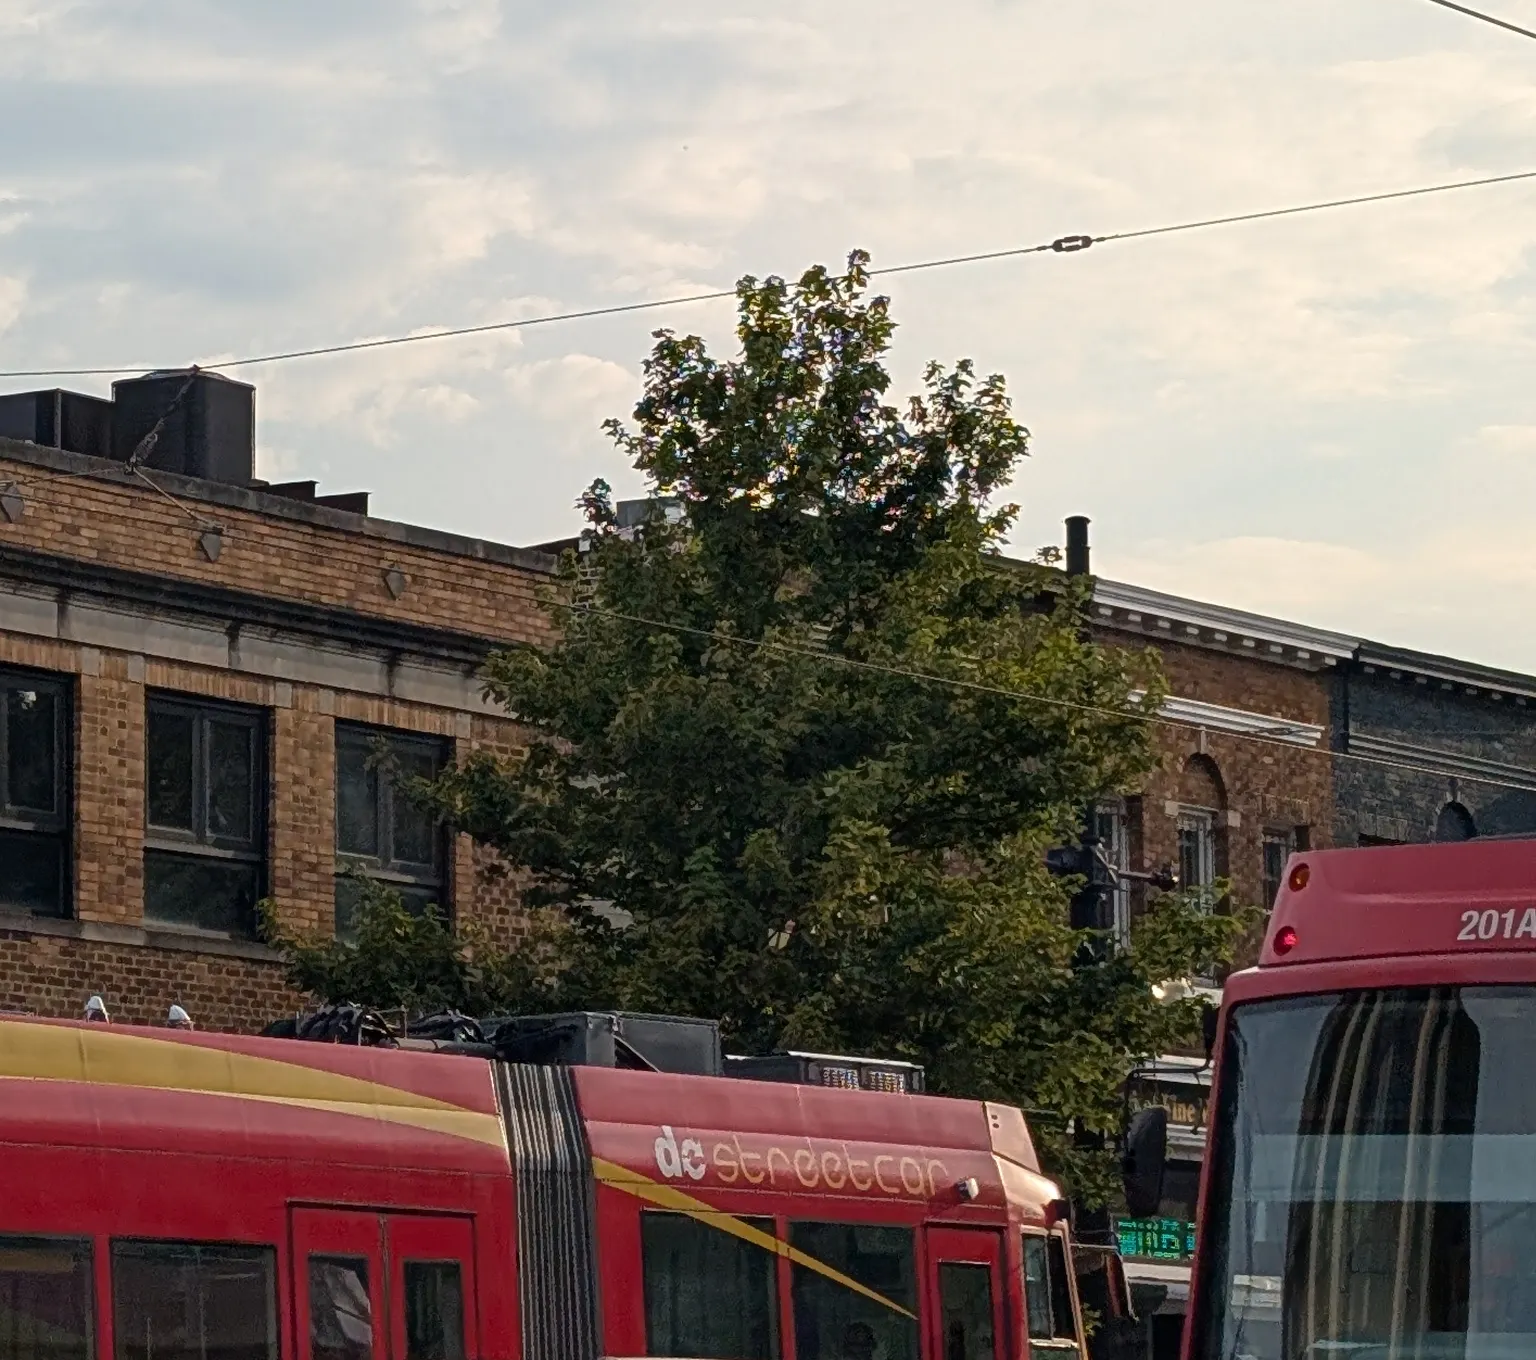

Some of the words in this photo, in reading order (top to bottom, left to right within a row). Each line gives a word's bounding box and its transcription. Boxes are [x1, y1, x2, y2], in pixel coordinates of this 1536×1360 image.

[1456, 907, 1536, 941] 201A
[654, 1124, 708, 1181] dc
[712, 1134, 950, 1198] streetcar
